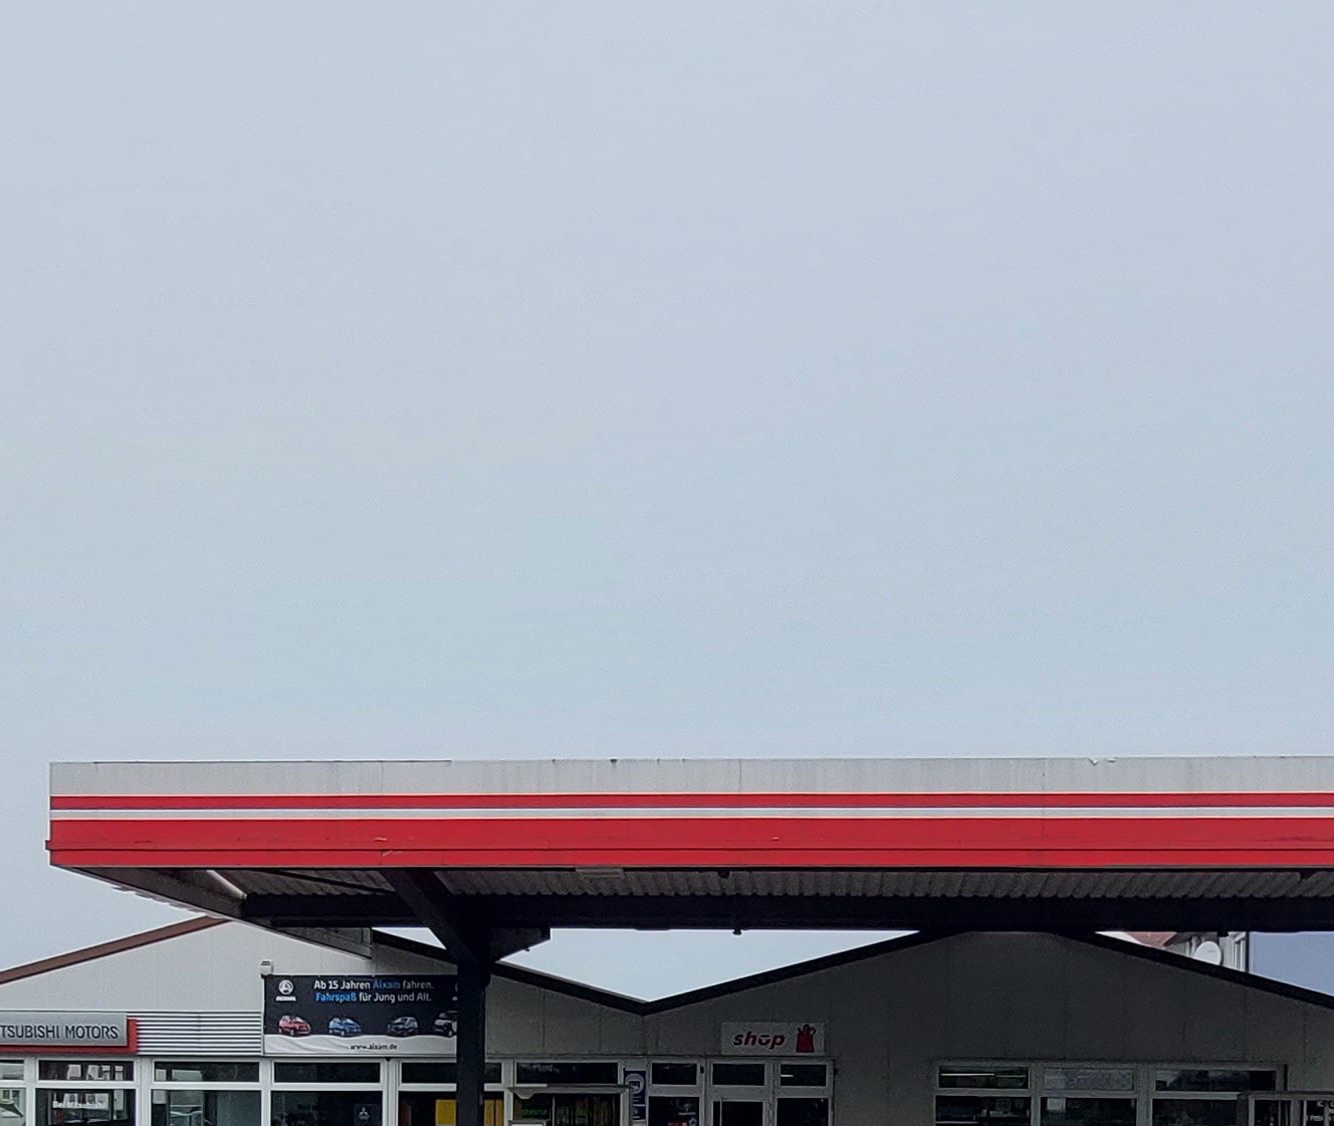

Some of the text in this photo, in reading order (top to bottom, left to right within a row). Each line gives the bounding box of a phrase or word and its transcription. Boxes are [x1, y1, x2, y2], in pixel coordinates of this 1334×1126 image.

[313, 979, 327, 990] Ab
[328, 980, 339, 990] 15
[340, 979, 371, 990] Jahren
[402, 979, 435, 990] fahren.
[315, 991, 357, 1004] Fahrspaß
[359, 991, 373, 1002] für
[373, 992, 396, 1004] Jung
[397, 991, 415, 1002] und
[65, 1025, 119, 1039] MOTORS
[733, 1030, 786, 1050] shop
